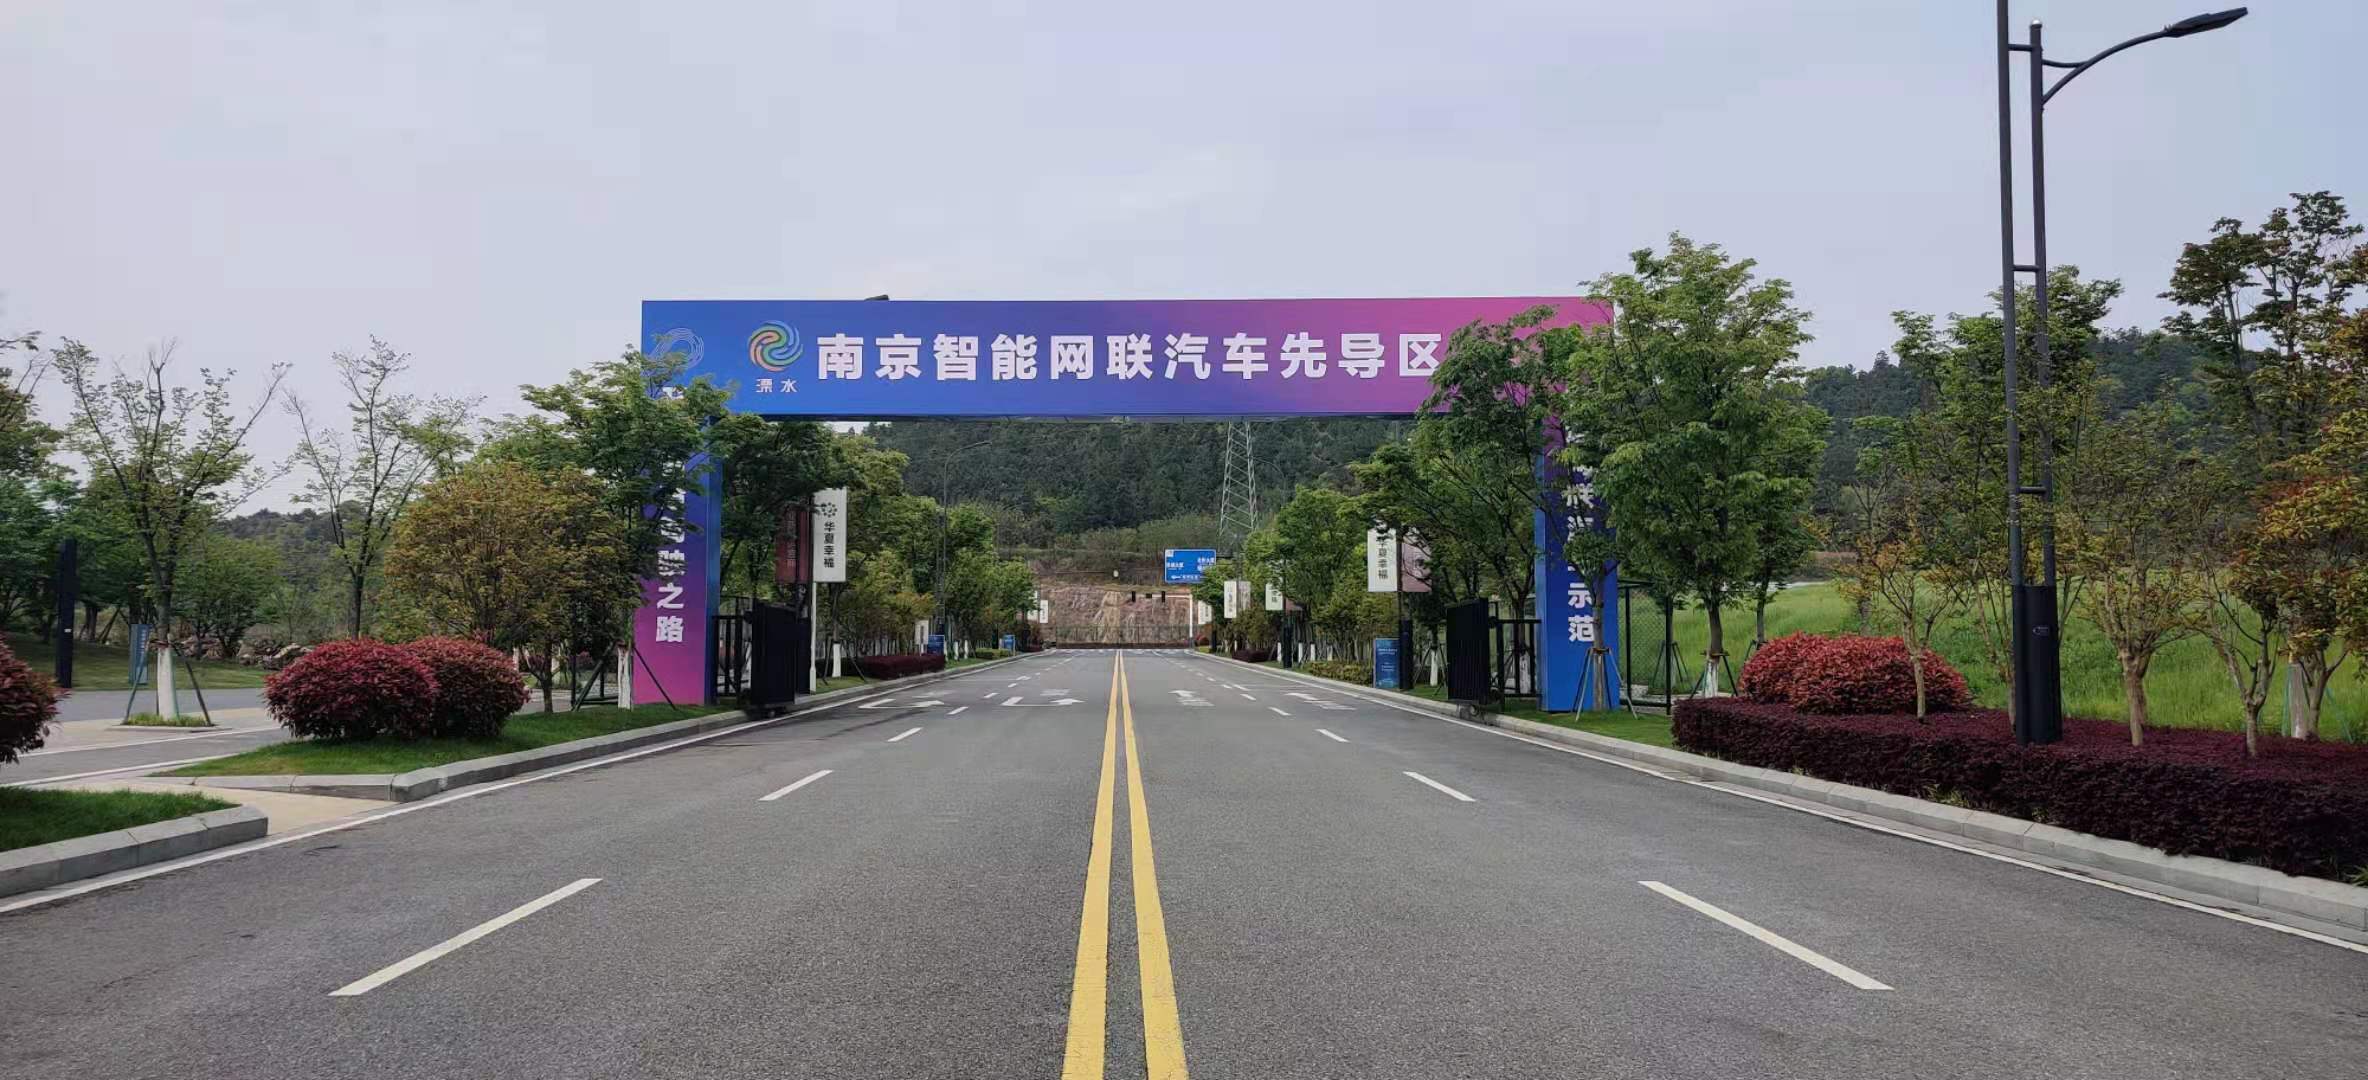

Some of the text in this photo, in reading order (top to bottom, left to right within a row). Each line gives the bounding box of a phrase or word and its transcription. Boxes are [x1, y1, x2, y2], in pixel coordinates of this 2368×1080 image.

[817, 332, 1443, 381] 南京智能网联汽车先导区
